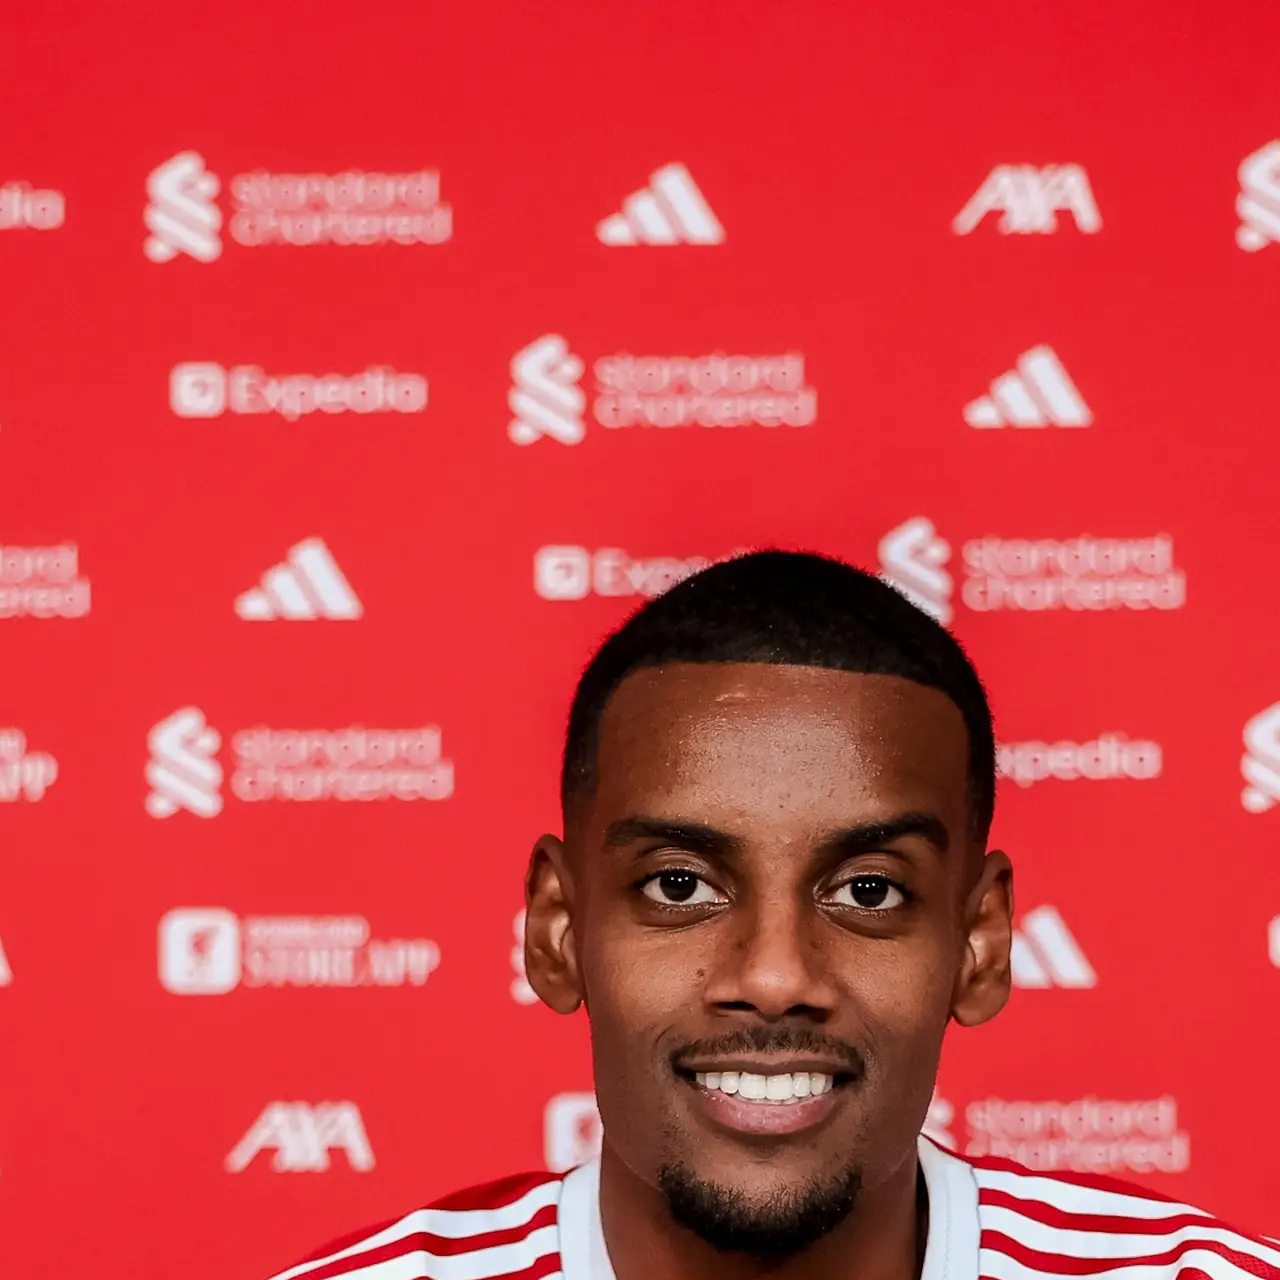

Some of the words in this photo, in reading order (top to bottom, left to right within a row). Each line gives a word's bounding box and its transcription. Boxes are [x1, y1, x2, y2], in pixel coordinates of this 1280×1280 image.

[953, 163, 1102, 235] AXA
[228, 365, 428, 421] Expedia
[226, 1101, 375, 1172] AXA
